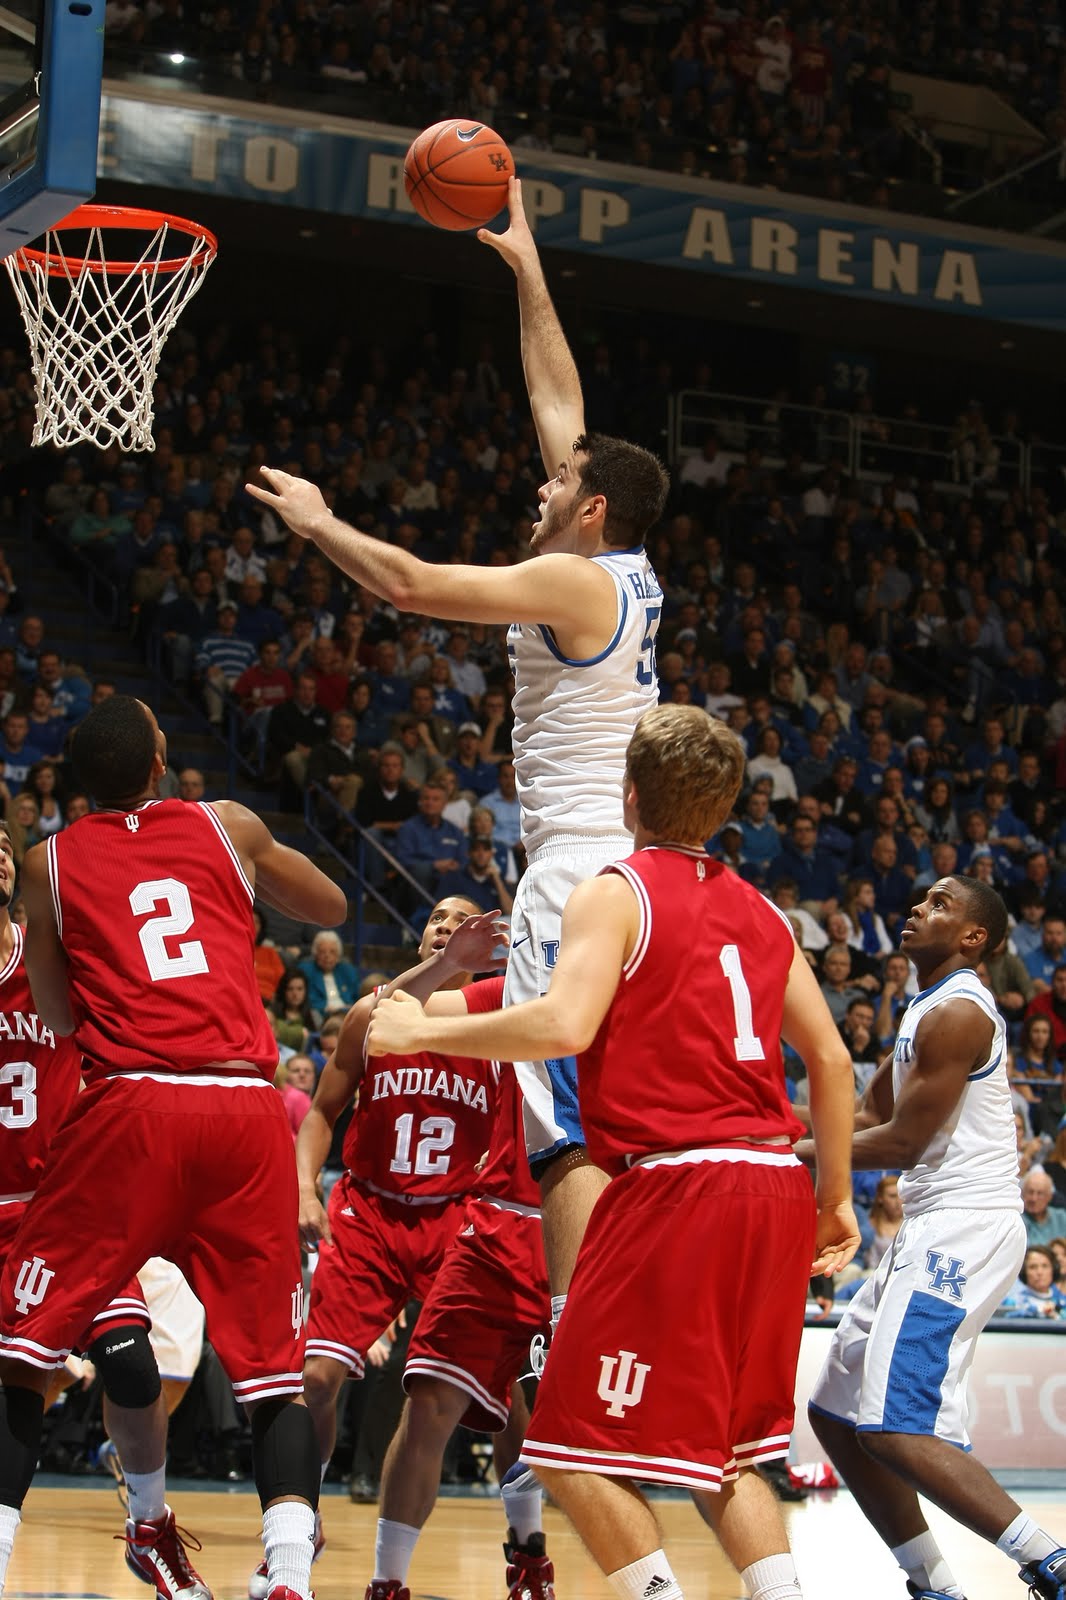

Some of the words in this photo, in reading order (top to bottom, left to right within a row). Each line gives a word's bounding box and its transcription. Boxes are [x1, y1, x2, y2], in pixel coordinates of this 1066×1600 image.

[182, 121, 298, 193] TO
[367, 153, 630, 243] RPP
[682, 206, 983, 306] ARENA
[128, 877, 210, 982] 2
[719, 944, 766, 1061] 1
[0, 1061, 38, 1129] 3
[372, 1067, 489, 1114] INDIANA
[389, 1113, 456, 1175] 12
[925, 1250, 968, 1300] UK
[643, 1578, 673, 1598] adidas
